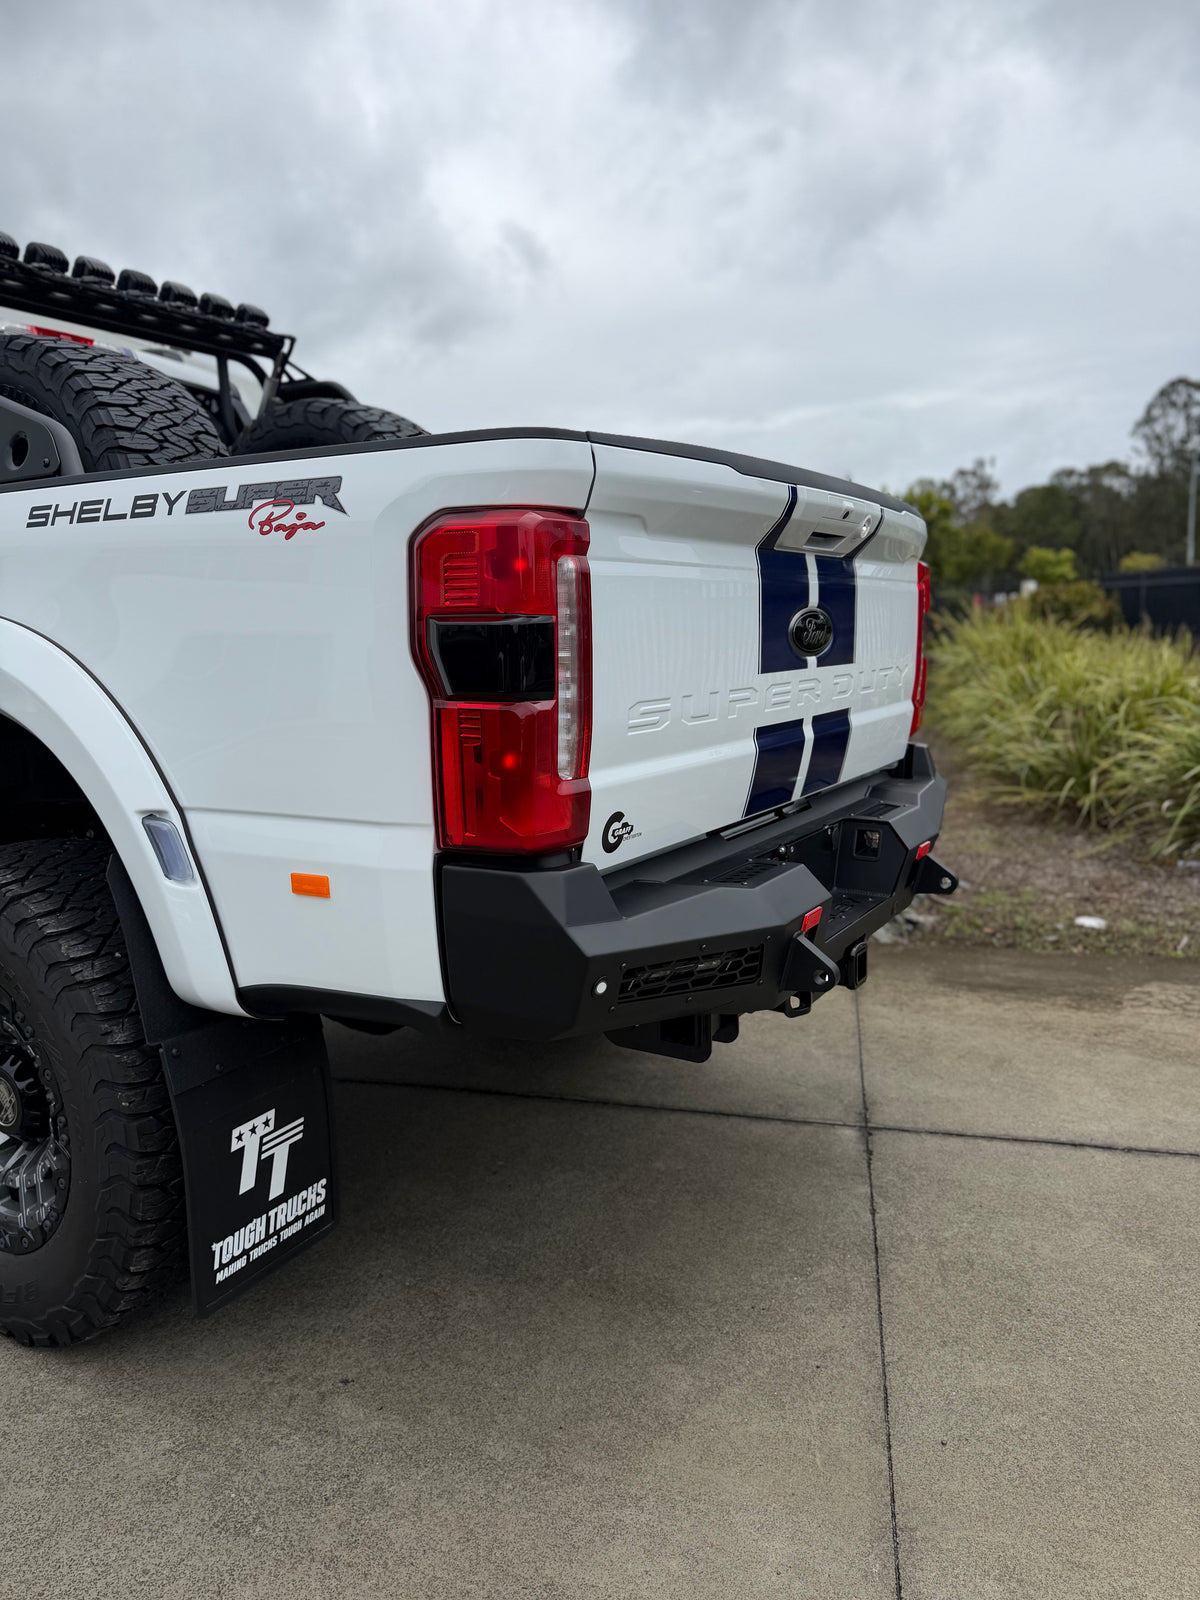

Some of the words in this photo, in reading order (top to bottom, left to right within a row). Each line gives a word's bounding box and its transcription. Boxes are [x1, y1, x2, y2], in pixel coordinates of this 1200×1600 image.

[26, 490, 187, 528] SHELBY
[185, 475, 350, 517] SUPER
[249, 499, 326, 541] Baja
[802, 617, 827, 646] Ford
[628, 678, 822, 735] SUPER
[832, 664, 909, 700] DUTY
[211, 1214, 267, 1270] TOUGH
[268, 1178, 327, 1234] TRUCKS
[215, 1255, 247, 1285] MAKING
[249, 1235, 278, 1262] TRUCKS
[280, 1219, 302, 1242] TOUGH
[304, 1204, 326, 1227] AGAIN
